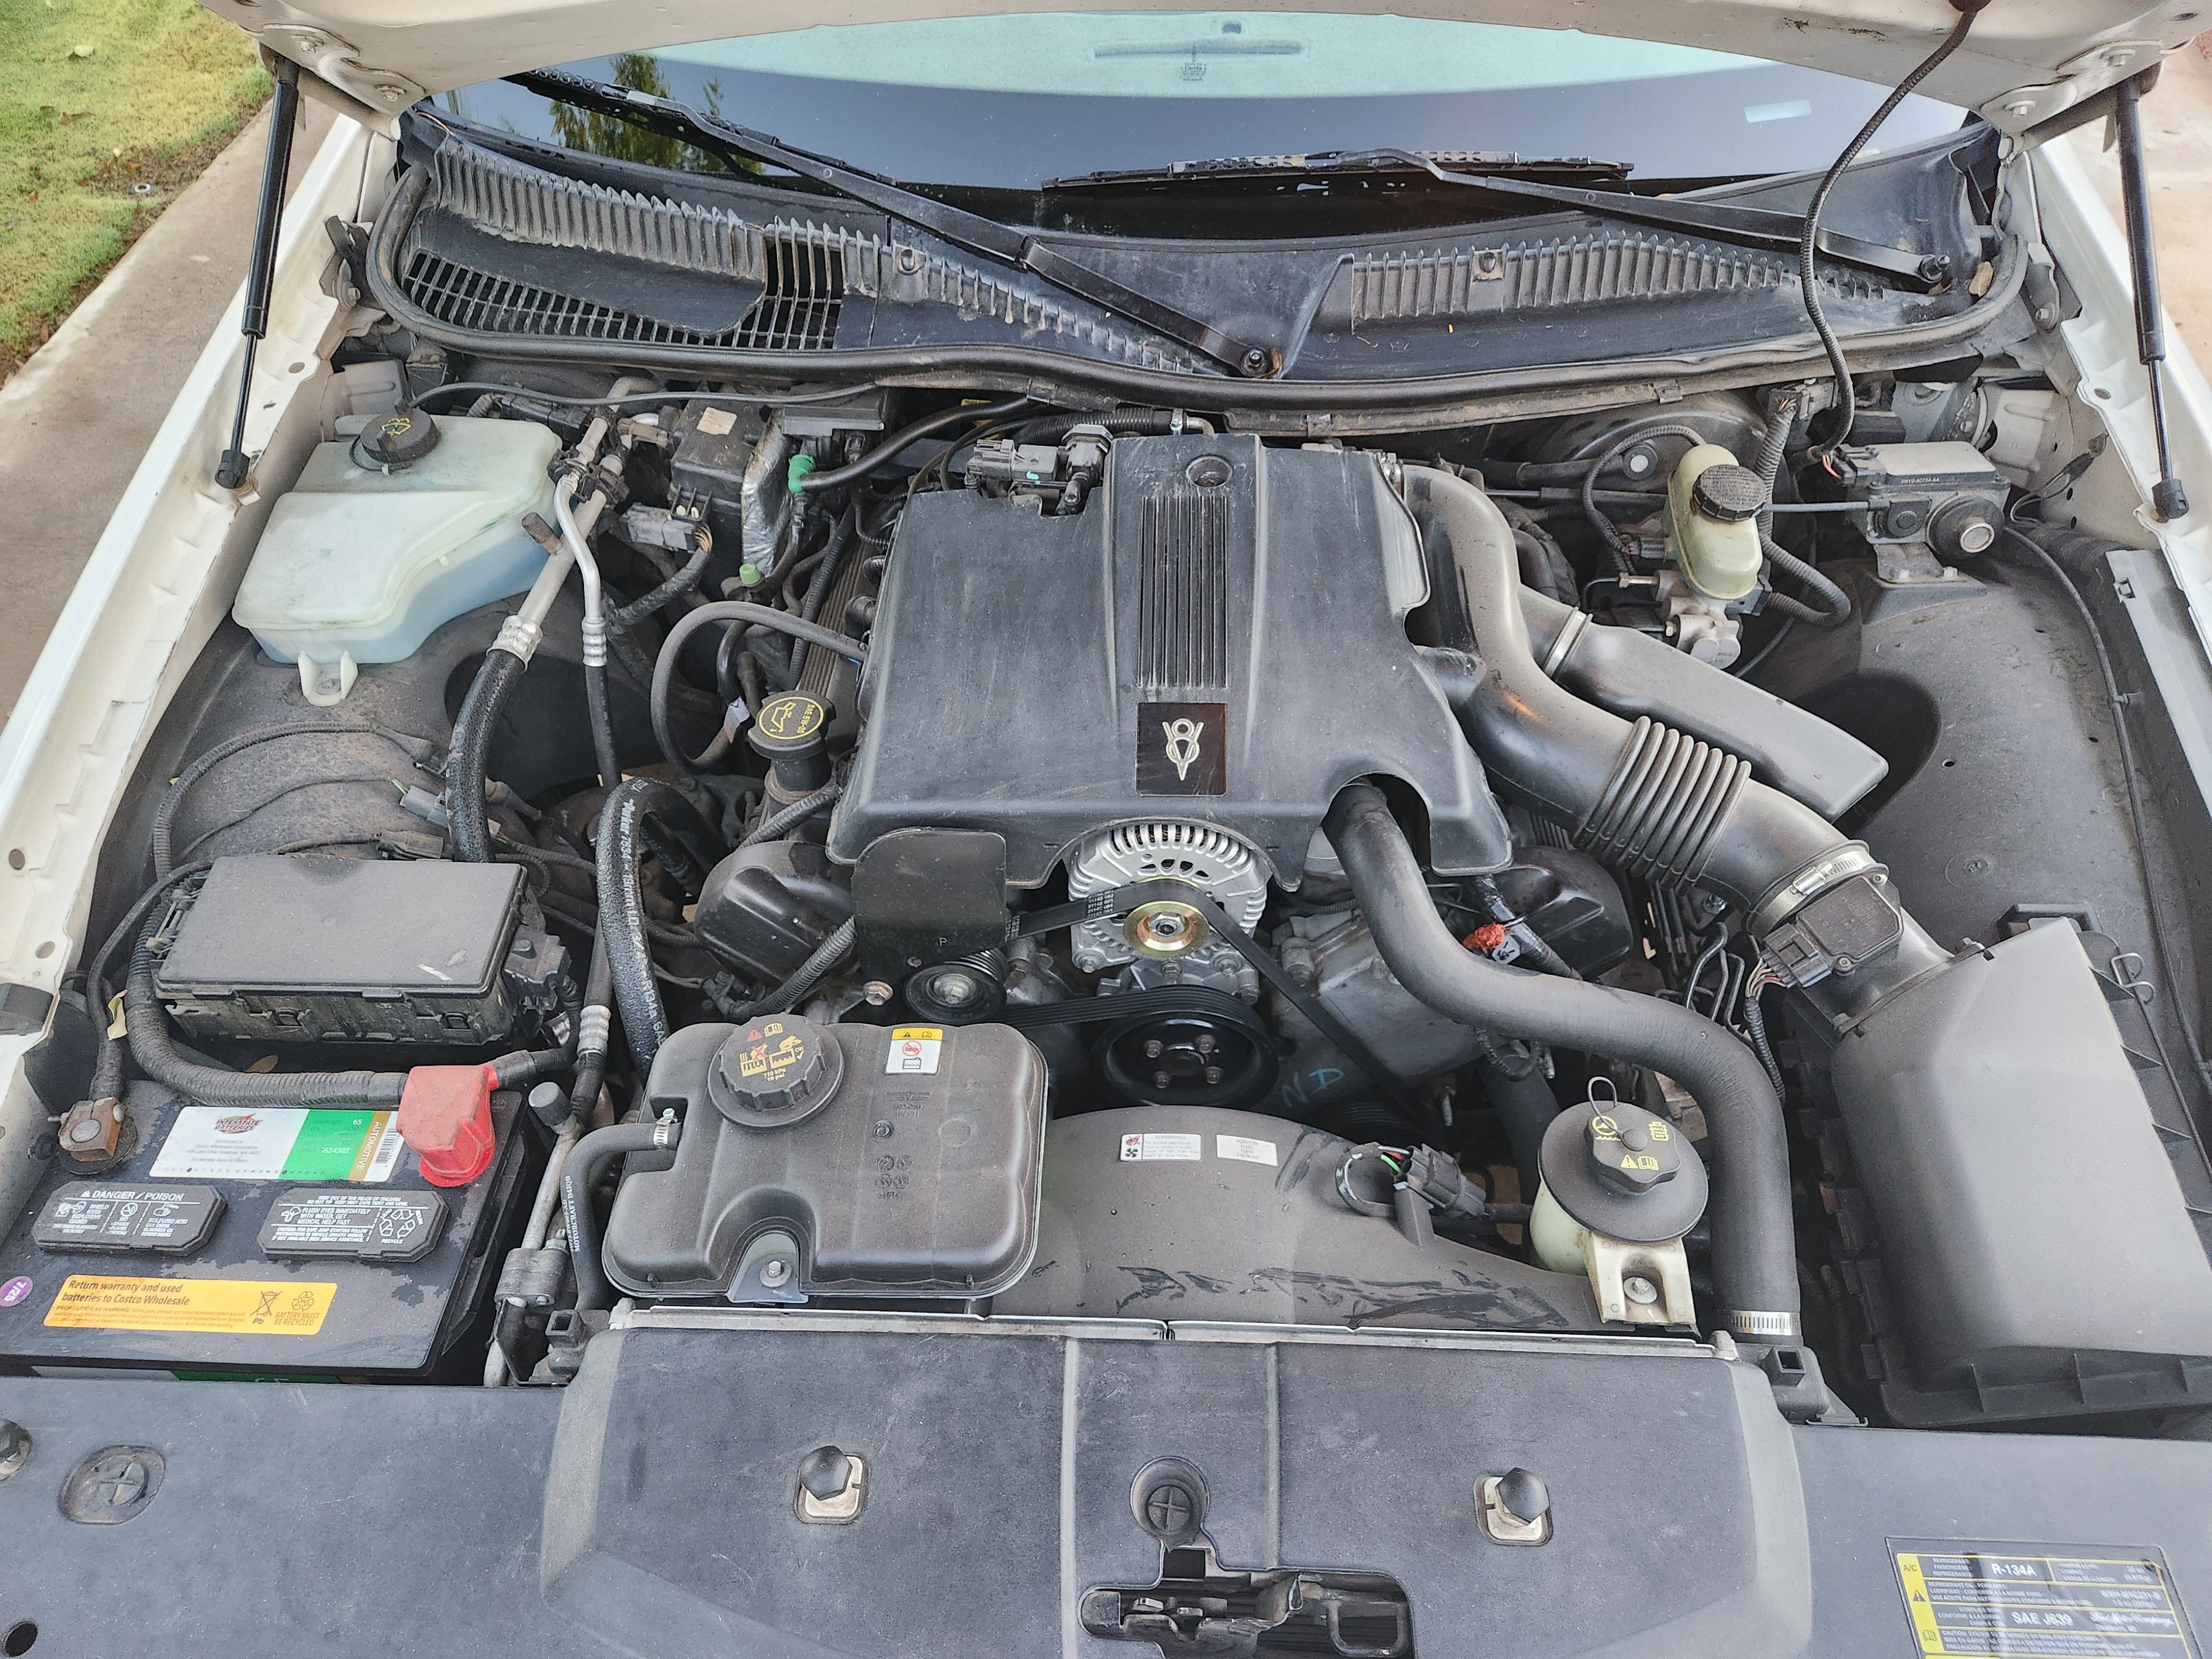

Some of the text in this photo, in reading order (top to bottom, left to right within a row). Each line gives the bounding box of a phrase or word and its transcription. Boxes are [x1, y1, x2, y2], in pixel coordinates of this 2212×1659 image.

[797, 704, 815, 734] SAE 5W-20
[940, 937, 947, 946] P
[775, 1072, 785, 1081] psi
[356, 1121, 383, 1170] AUTOMOTIVE
[91, 1190, 136, 1199] DANGER
[144, 1192, 185, 1202] POISON
[568, 1200, 581, 1253] MOTORCRAFT
[4, 1281, 27, 1302] 7/25
[68, 1280, 184, 1293] Return warranty and used
[61, 1292, 190, 1306] batteries to Costco Wholesale
[1991, 1563, 2038, 1577] R-134A
[2010, 1611, 2041, 1625] SAE
